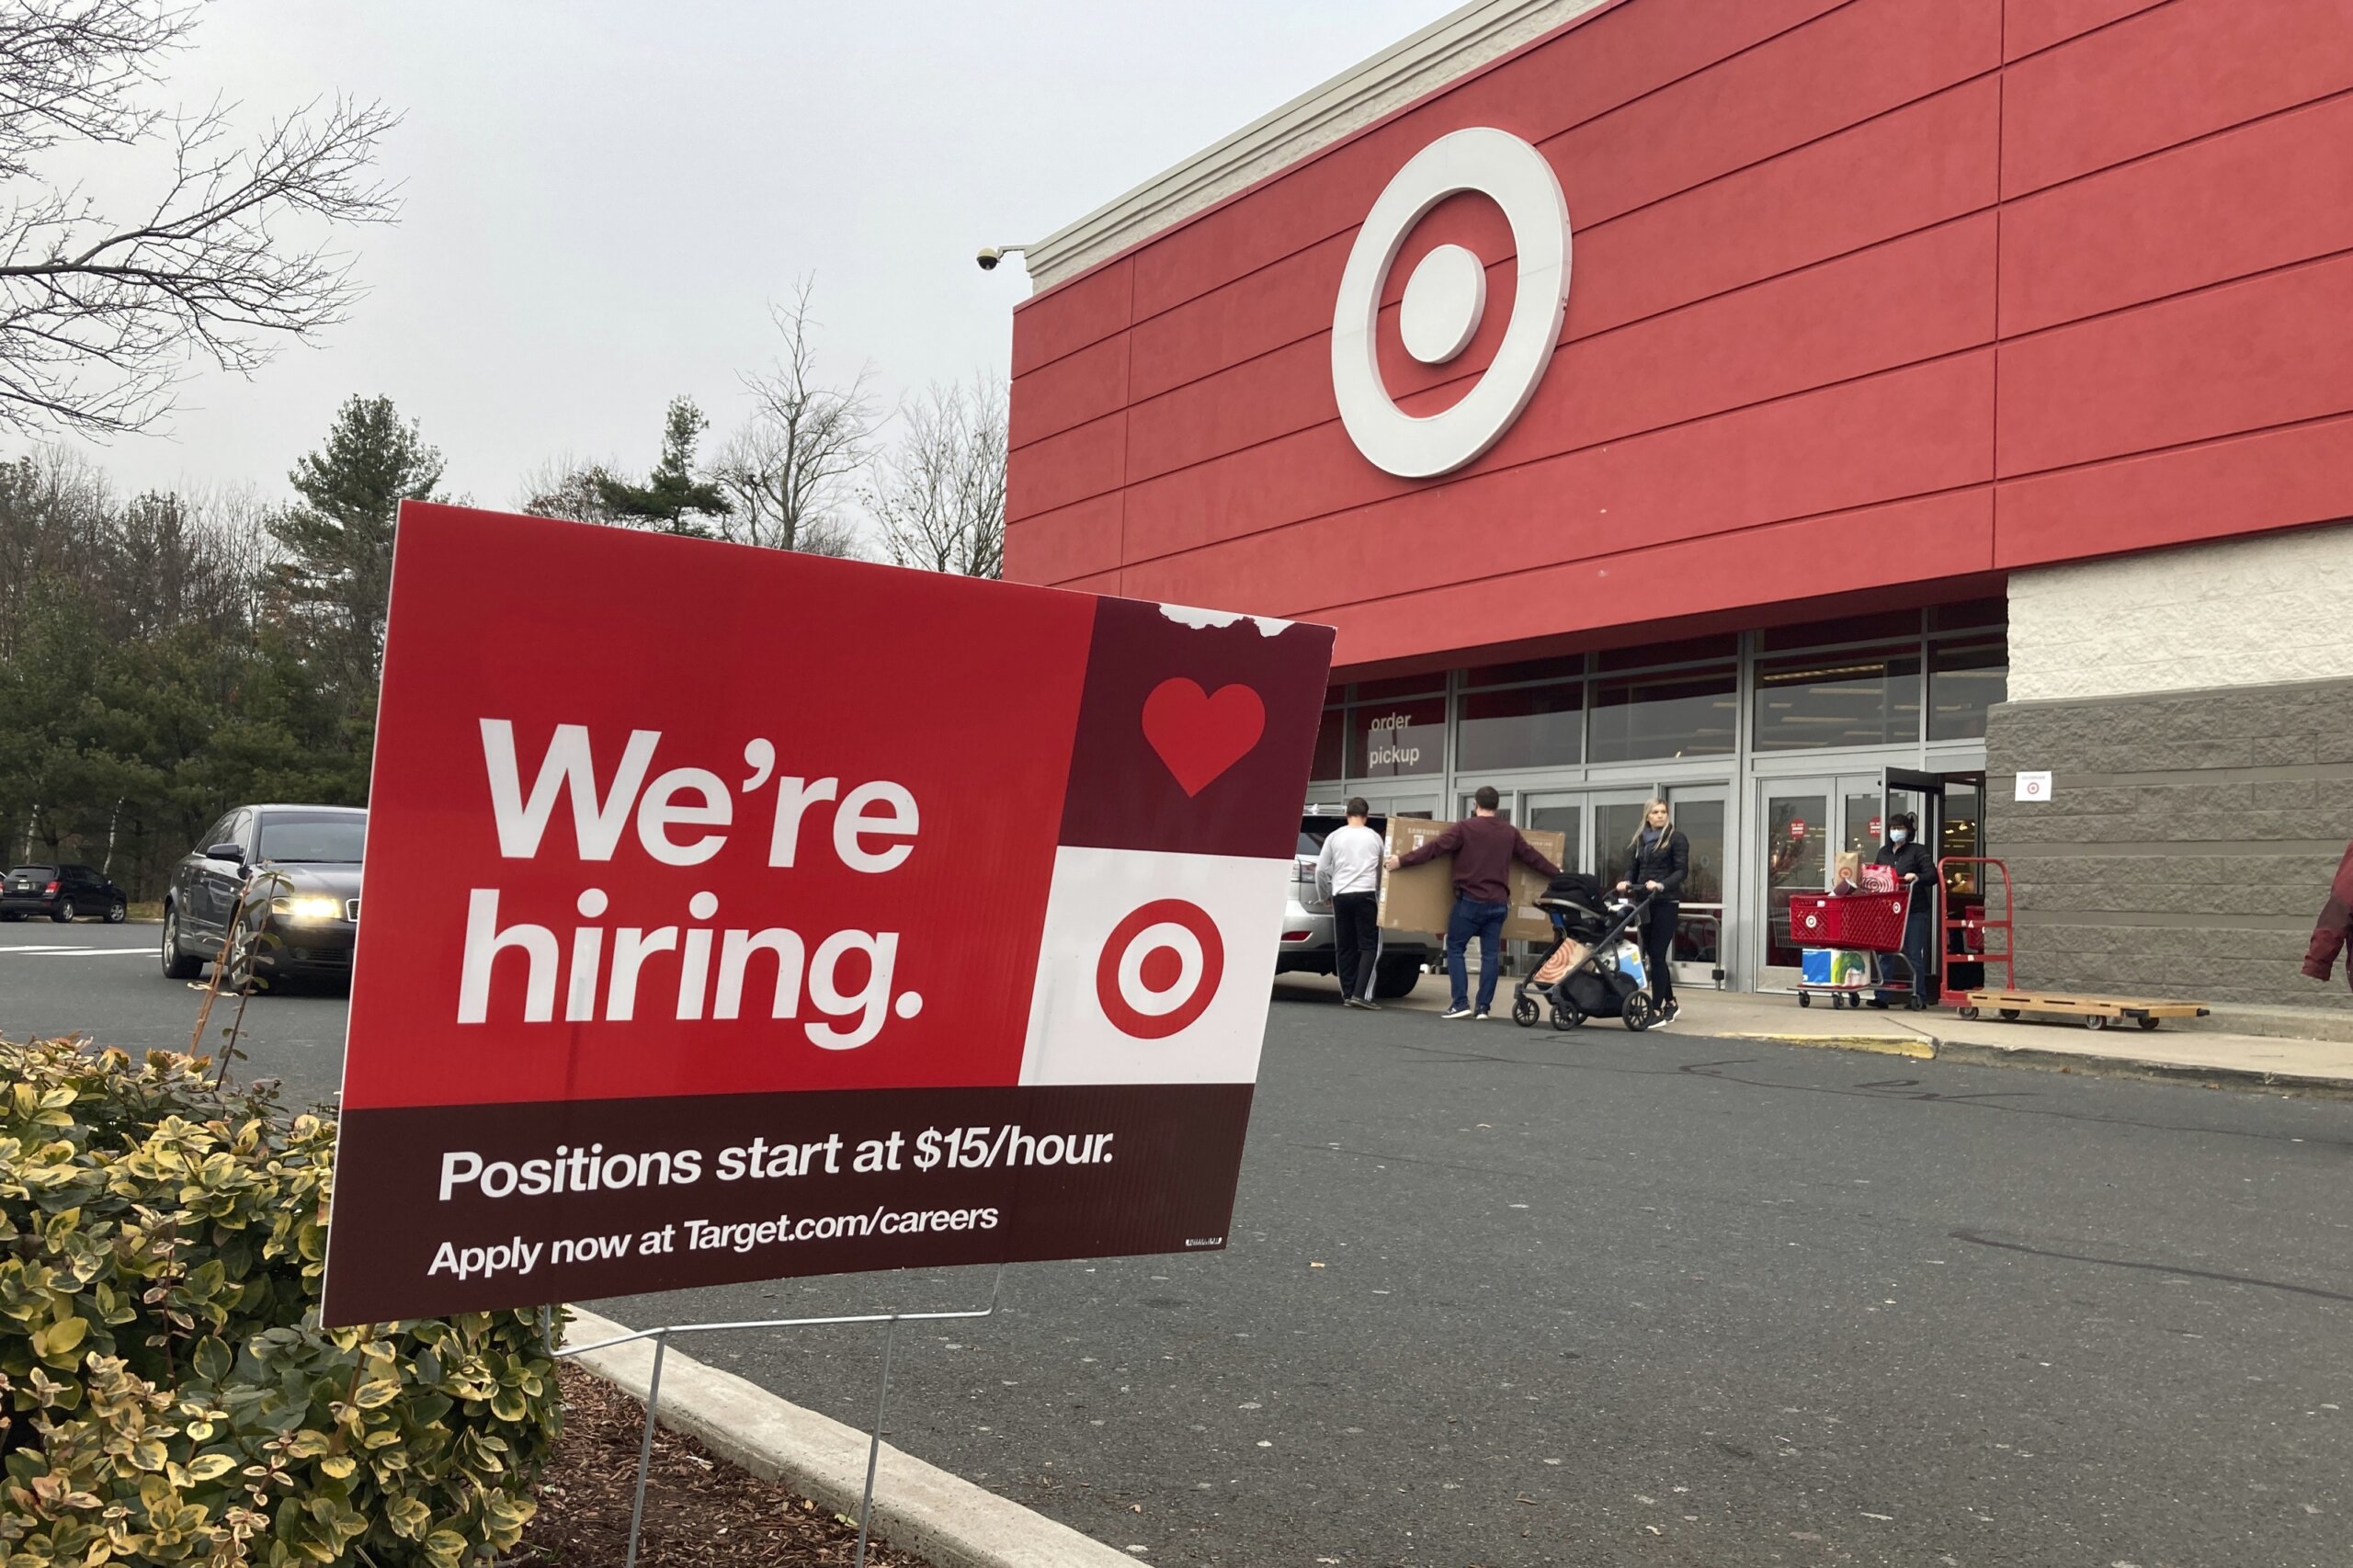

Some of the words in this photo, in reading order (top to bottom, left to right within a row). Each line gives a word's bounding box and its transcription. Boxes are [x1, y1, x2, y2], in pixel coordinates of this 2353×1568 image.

[1370, 745, 1420, 769] pickup
[1371, 712, 1412, 732] order
[479, 718, 920, 874] We’re
[1407, 827, 1440, 836] SAMSUNG
[457, 888, 924, 1051] hiring.
[438, 1142, 702, 1201] Positions
[715, 1133, 844, 1181] start
[852, 1131, 905, 1173] at
[913, 1124, 1114, 1173] $15/hour.
[426, 1235, 544, 1282] Apply
[551, 1233, 632, 1265] now
[638, 1223, 676, 1256] at
[683, 1205, 999, 1253] Target.com/careers
